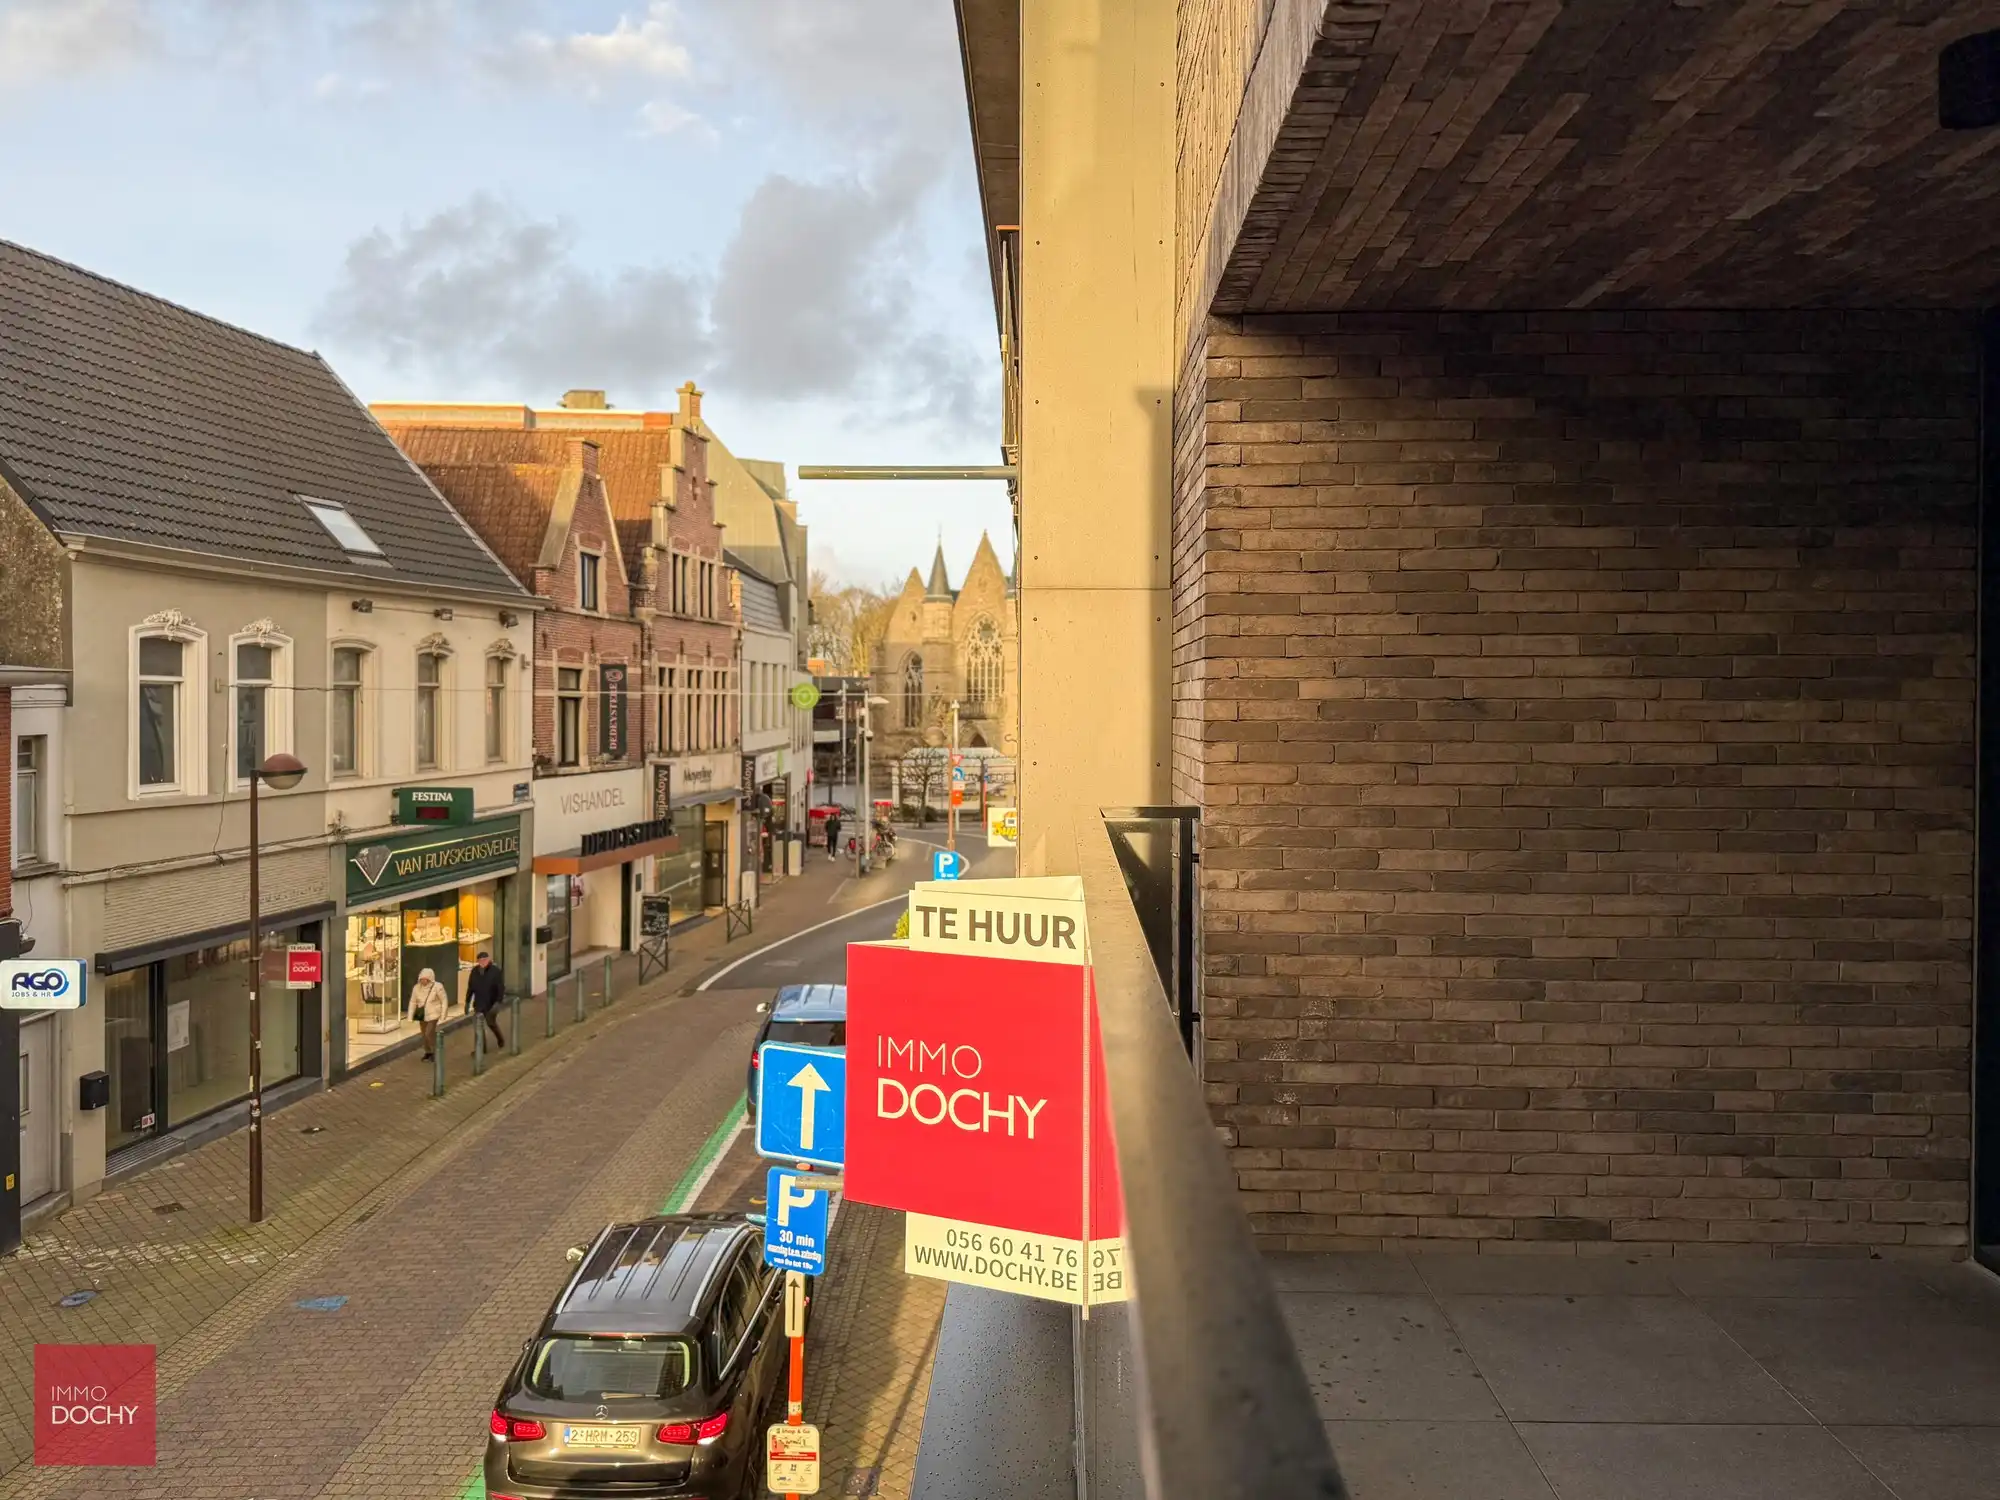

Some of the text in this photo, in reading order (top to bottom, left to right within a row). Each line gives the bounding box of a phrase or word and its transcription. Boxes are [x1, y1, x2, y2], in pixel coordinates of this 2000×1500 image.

[411, 791, 453, 802] FESTINA
[560, 787, 625, 815] VISHANDEL
[395, 835, 519, 876] VAN RUYSKENSVELDE
[938, 853, 954, 873] P
[916, 905, 1077, 950] TE HUUR
[12, 971, 63, 991] AGO
[877, 1034, 982, 1079] IMMO
[877, 1077, 1048, 1139] DOCHY
[777, 1174, 815, 1227] P
[779, 1229, 815, 1248] 30 min
[946, 1228, 1078, 1268] 056 60 41 76
[914, 1245, 1078, 1292] WWW.DOCHY.BE
